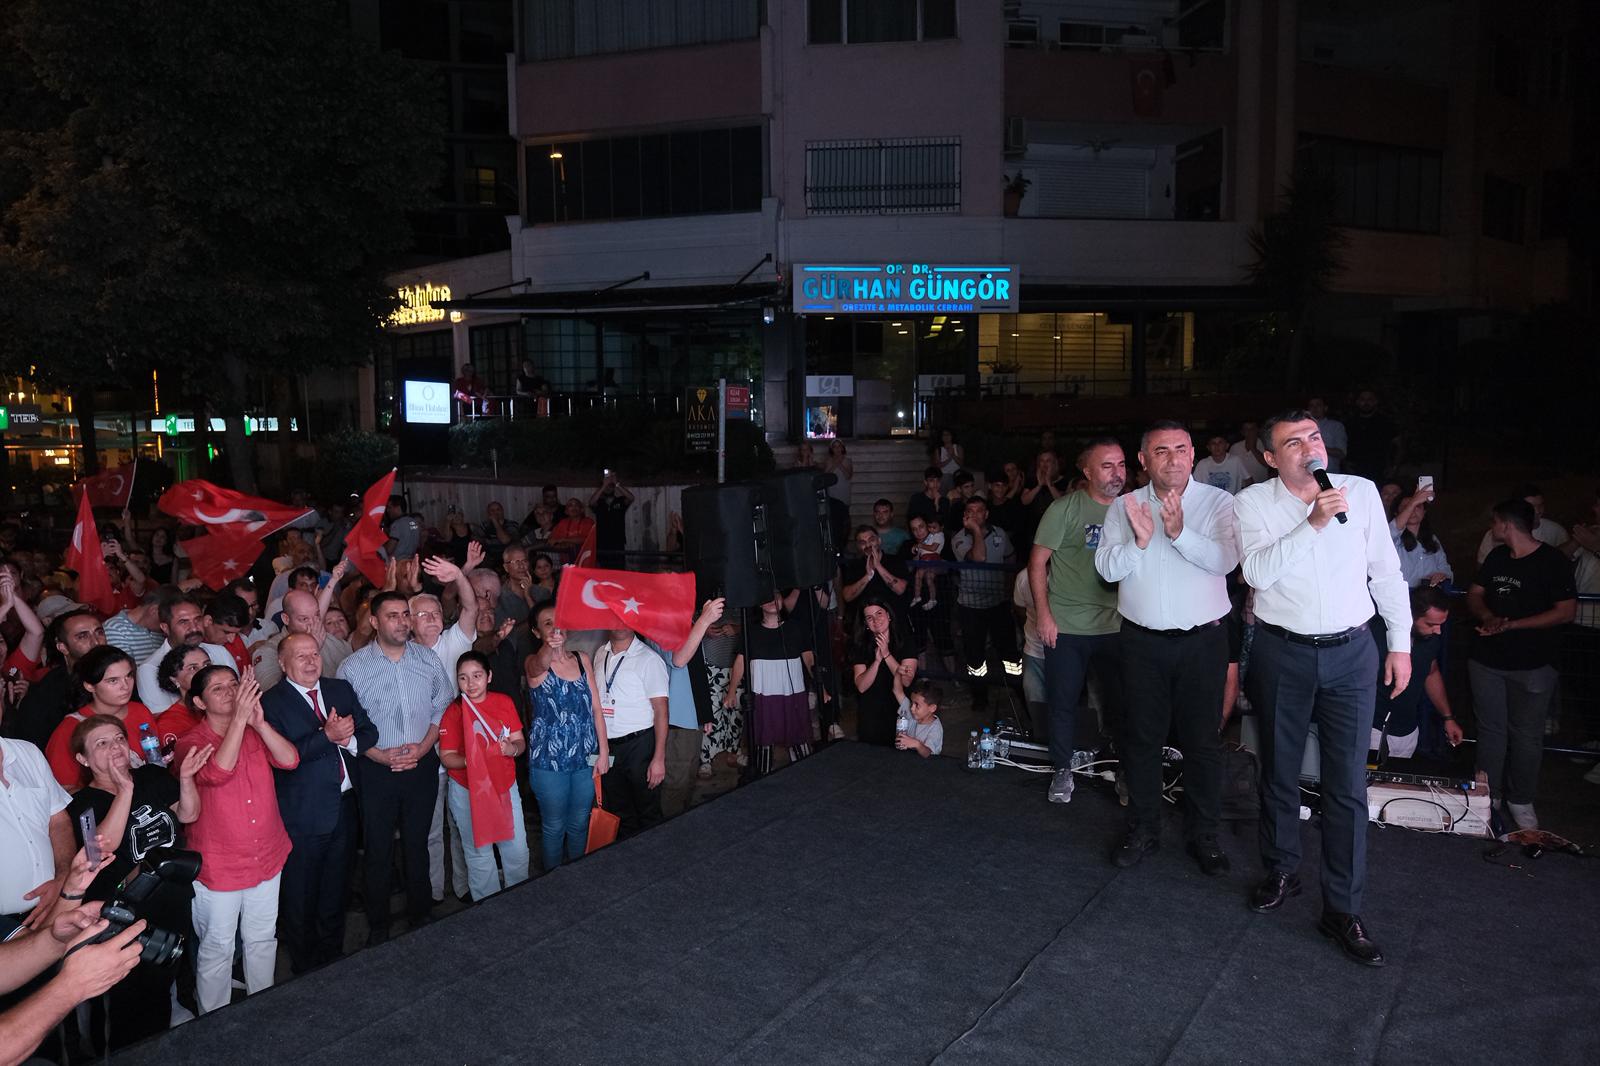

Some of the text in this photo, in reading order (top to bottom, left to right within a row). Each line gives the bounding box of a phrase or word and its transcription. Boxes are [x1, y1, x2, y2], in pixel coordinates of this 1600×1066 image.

[886, 264, 932, 274] OP. DR.
[802, 272, 1010, 301] GÜRHAN GÜNGÖR
[878, 303, 885, 312] &
